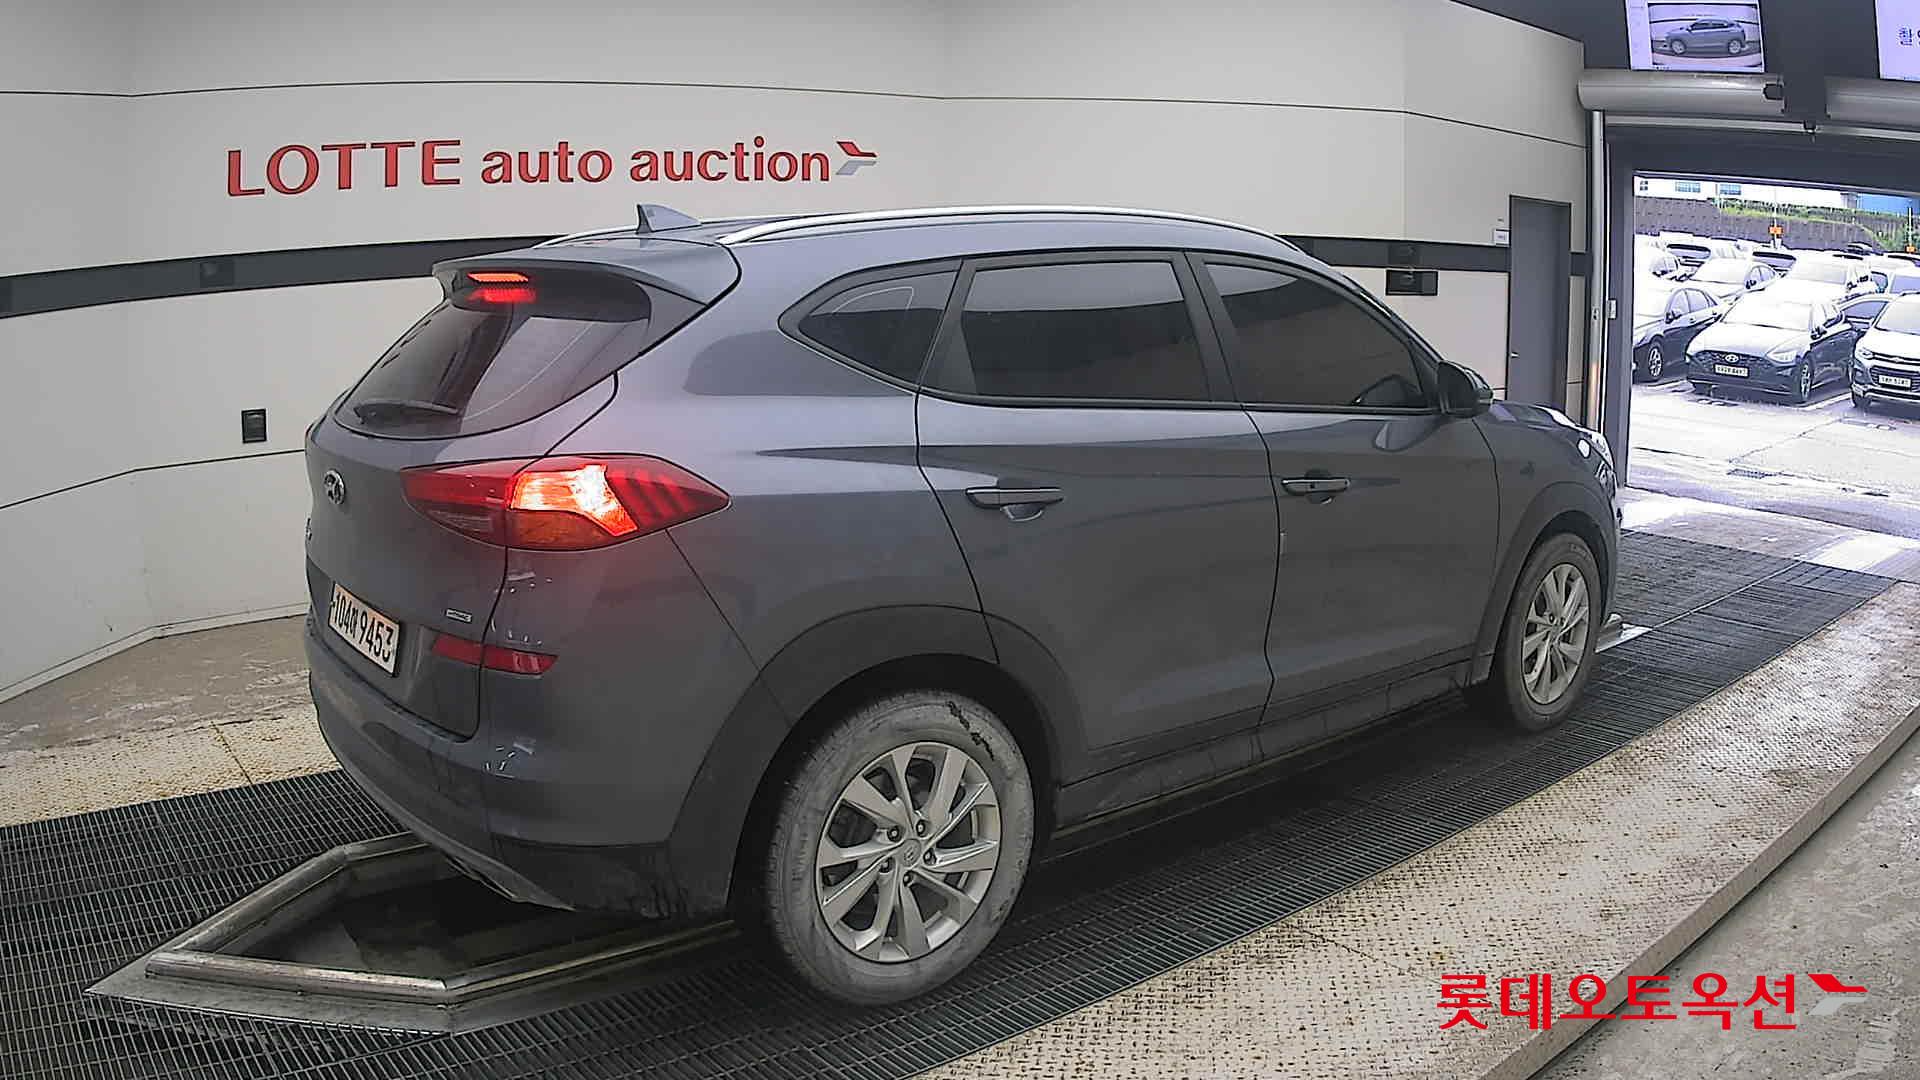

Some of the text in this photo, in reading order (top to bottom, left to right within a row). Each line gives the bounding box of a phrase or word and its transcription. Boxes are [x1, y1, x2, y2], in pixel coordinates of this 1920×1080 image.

[227, 137, 830, 197] LOTTE auto auction
[358, 610, 394, 662] 9453
